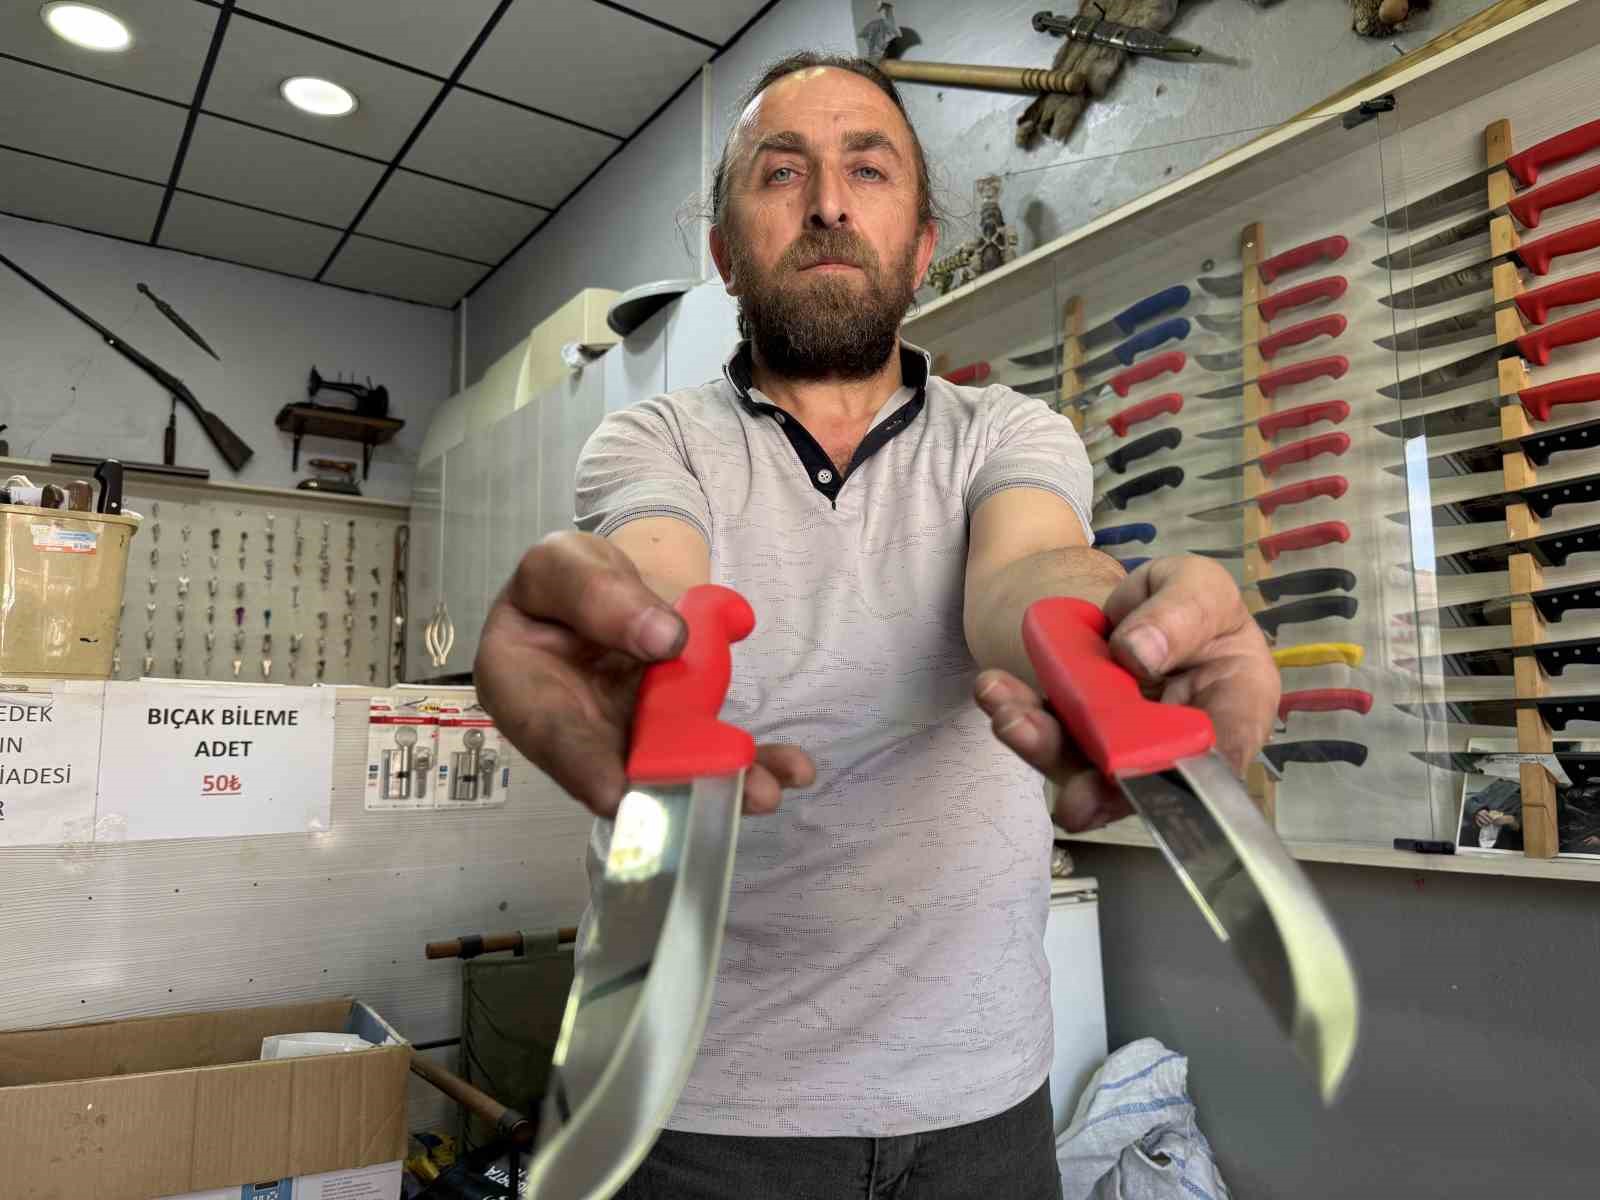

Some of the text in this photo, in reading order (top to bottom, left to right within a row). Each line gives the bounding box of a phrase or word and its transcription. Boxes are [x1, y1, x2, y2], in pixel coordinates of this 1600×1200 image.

[147, 705, 299, 729] BIÇAK BİLEME
[194, 740, 254, 758] ADET
[201, 774, 242, 795] 50₺
